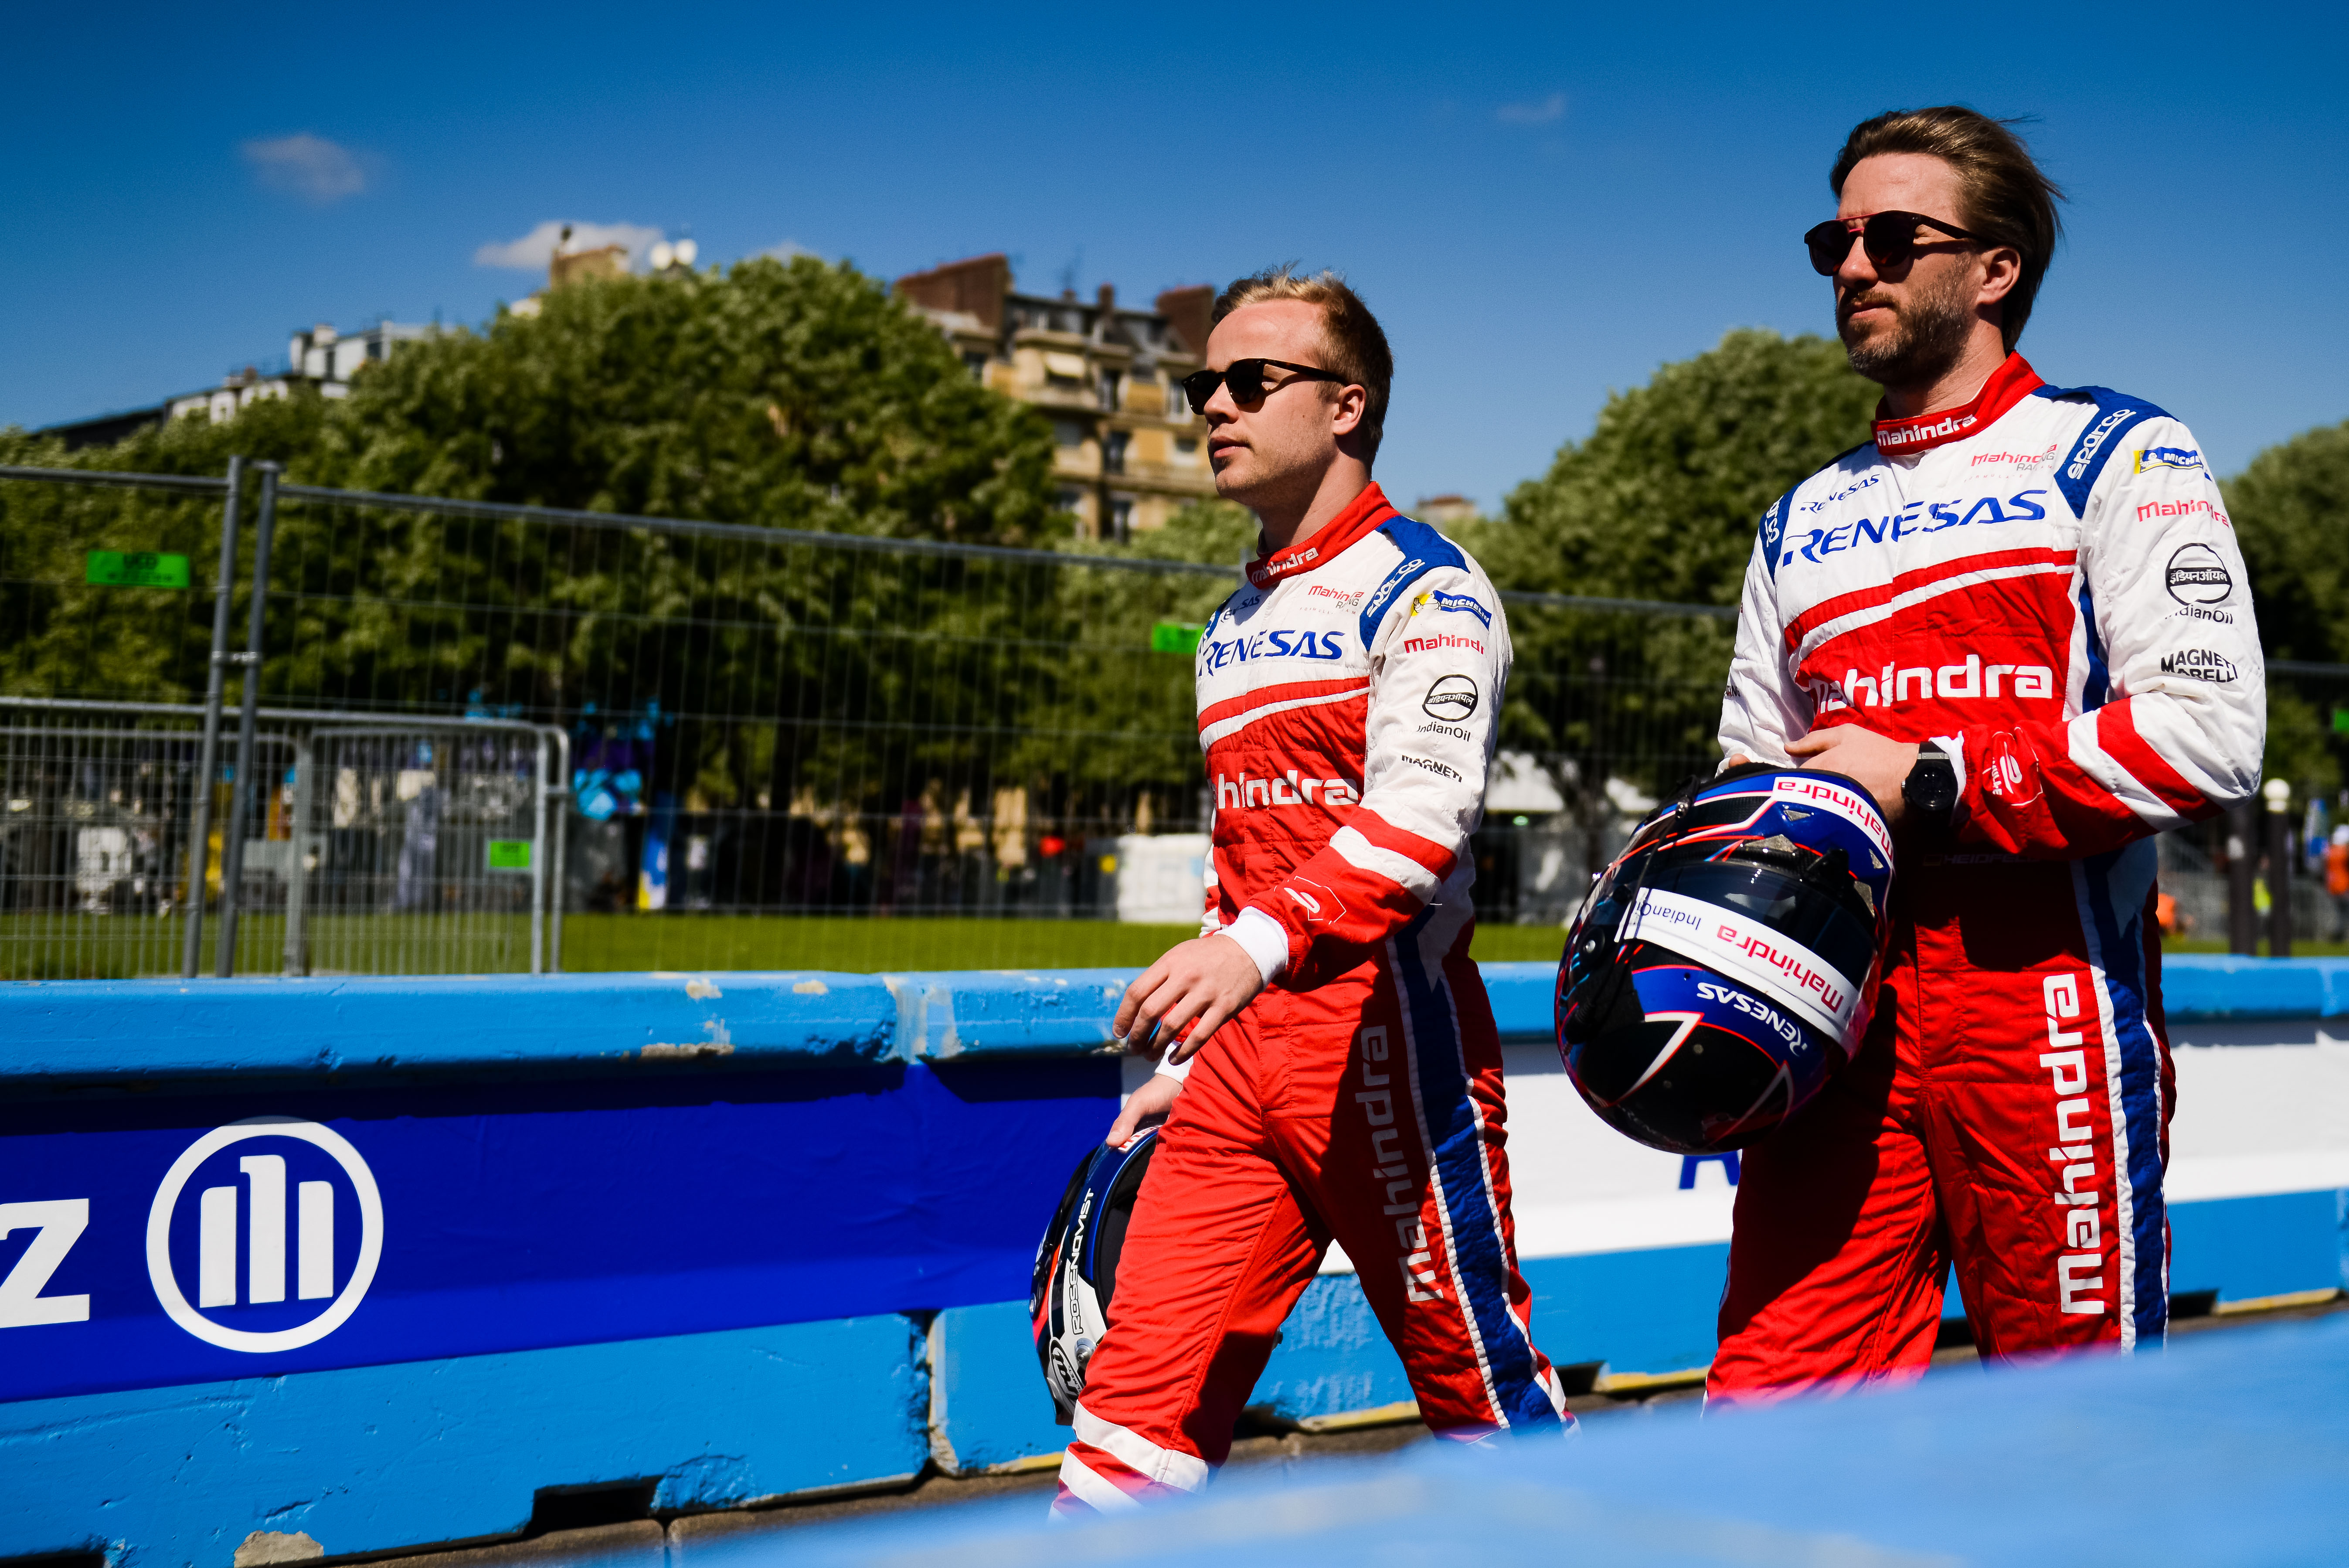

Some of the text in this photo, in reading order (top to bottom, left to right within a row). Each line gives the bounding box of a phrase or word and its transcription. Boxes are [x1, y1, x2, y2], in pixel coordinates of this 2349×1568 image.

[2067, 409, 2136, 480] sparco
[1783, 490, 2048, 568] RENESAS
[1441, 598, 1490, 623] MICHELIN
[1198, 629, 1346, 677] RENESAS
[1697, 982, 1807, 1057] RENESAS
[1069, 1187, 1095, 1336] ROSENQVIST
